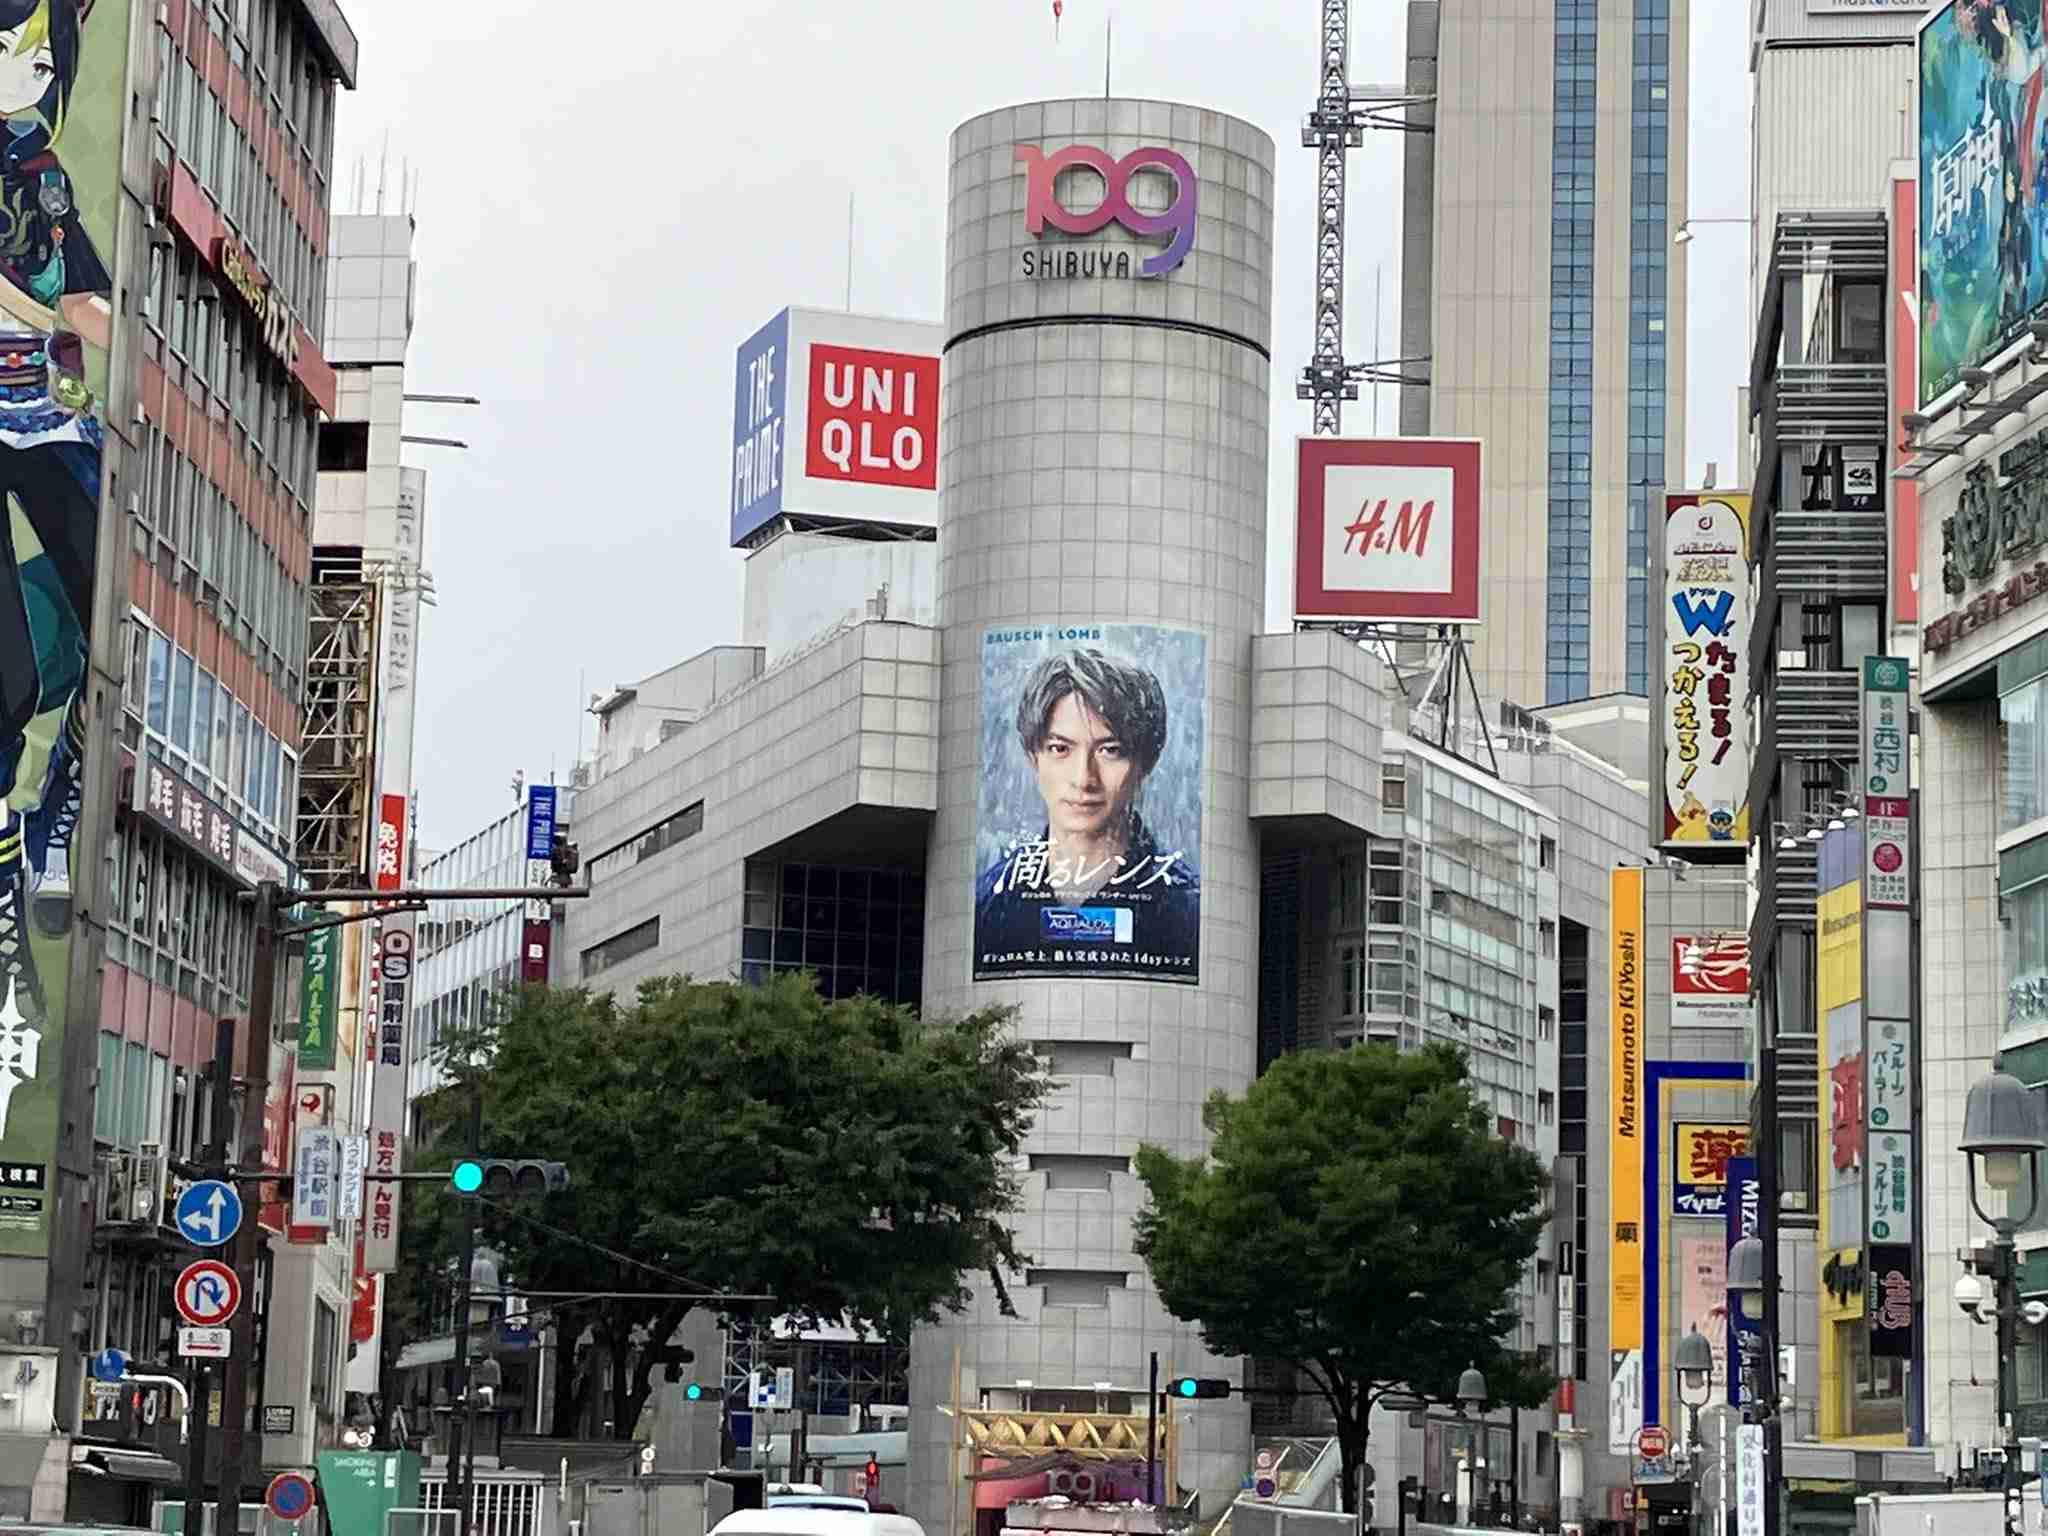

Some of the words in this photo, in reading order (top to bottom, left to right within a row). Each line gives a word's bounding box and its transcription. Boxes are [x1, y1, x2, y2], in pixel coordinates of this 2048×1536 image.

[1015, 144, 1198, 277] 109
[1022, 251, 1130, 280] SHIBUYA
[748, 345, 776, 433] THE
[823, 361, 917, 417] UNI
[733, 417, 782, 514] PRIME
[822, 418, 924, 473] QLO
[1343, 498, 1435, 558] H&M
[986, 630, 1043, 645] BAUSCH
[1058, 629, 1101, 641] LOMB
[378, 822, 399, 876] 免税
[993, 836, 1185, 894] 滴るレンズ
[1619, 1012, 1635, 1138] Matsumoto
